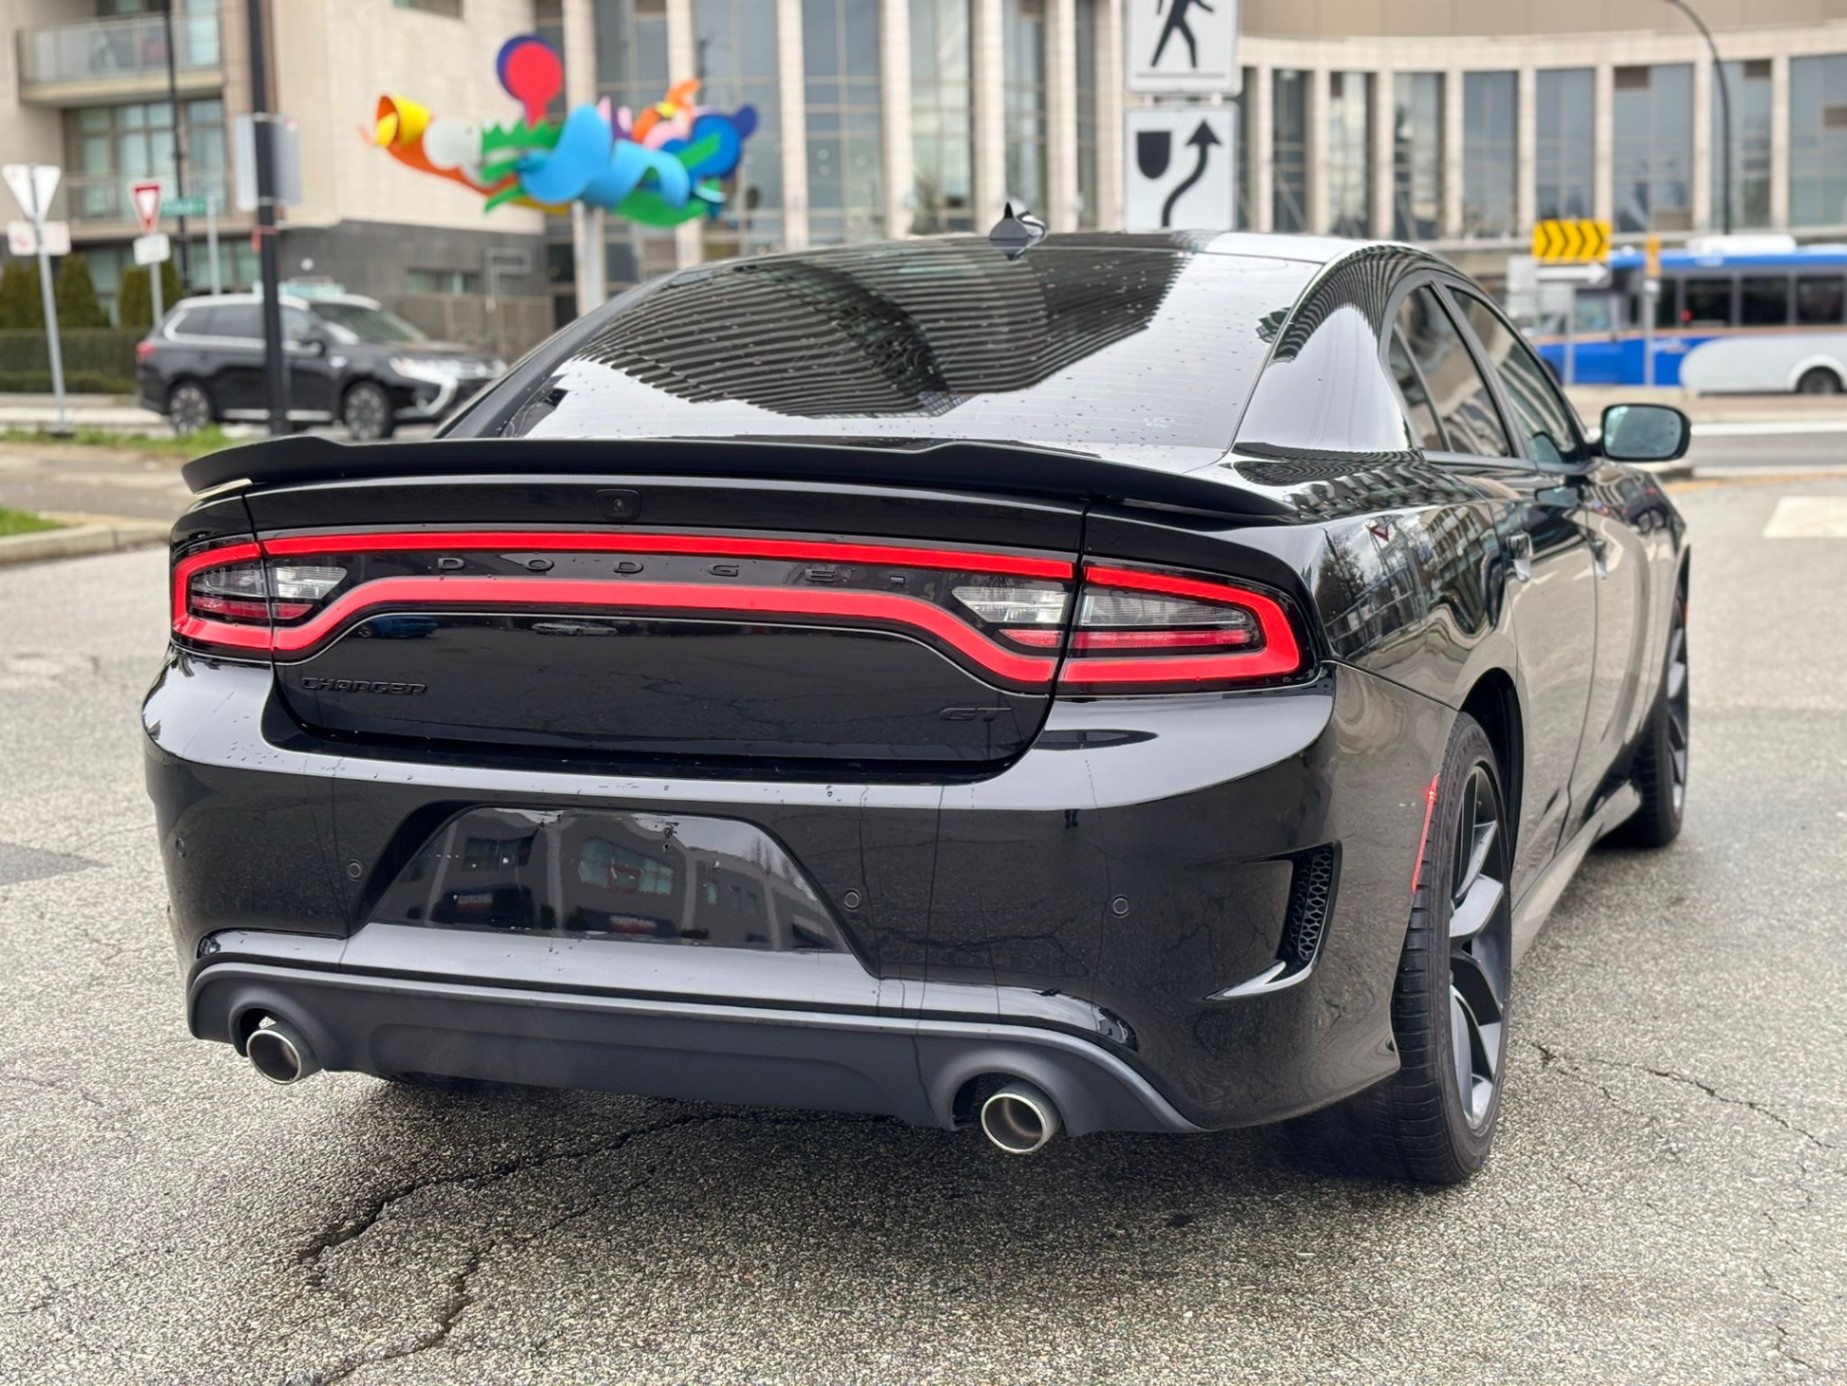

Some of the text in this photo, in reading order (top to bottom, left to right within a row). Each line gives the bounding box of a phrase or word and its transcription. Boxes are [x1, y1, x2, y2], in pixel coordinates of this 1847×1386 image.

[438, 557, 837, 583] DODGE
[302, 676, 428, 697] CHARGER
[940, 706, 1012, 721] GT
